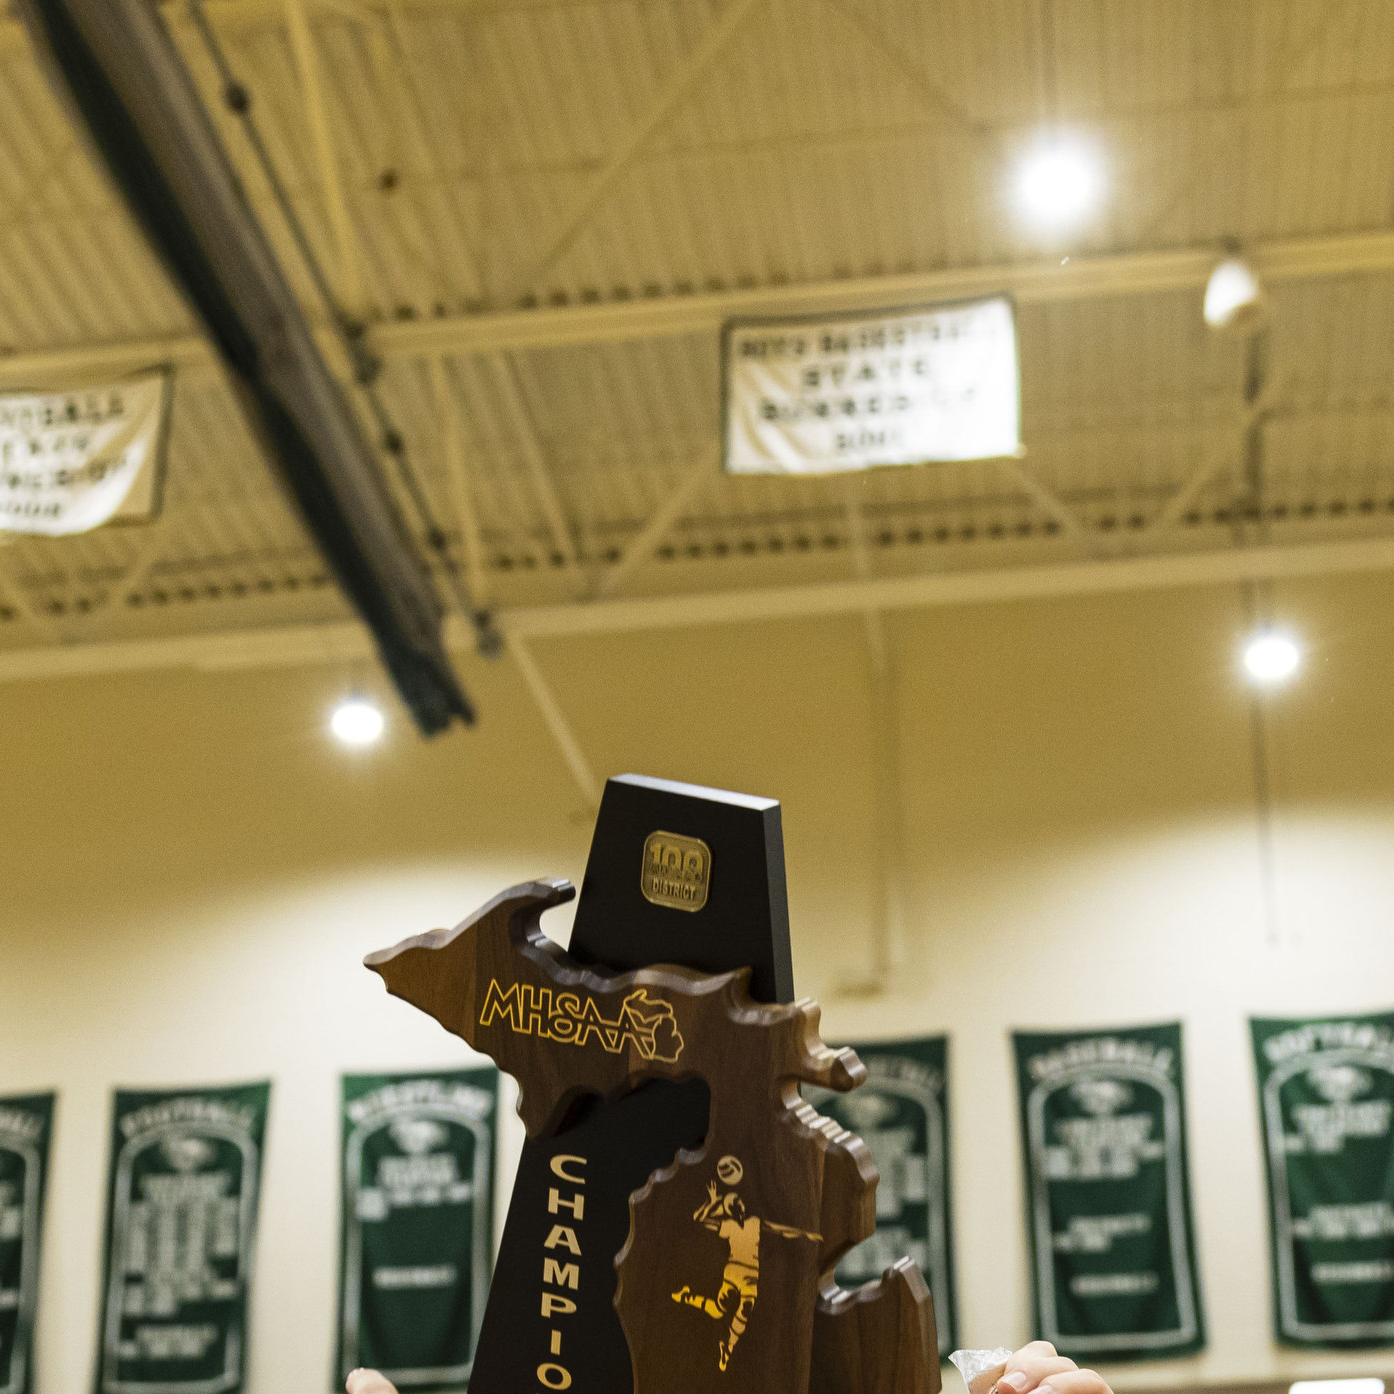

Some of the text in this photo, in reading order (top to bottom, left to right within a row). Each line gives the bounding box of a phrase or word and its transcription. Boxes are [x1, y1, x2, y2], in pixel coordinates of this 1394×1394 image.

[800, 356, 932, 391] STATE
[650, 842, 703, 875] 100
[652, 876, 697, 902] DISTRICT
[479, 978, 656, 1060] MHSAA
